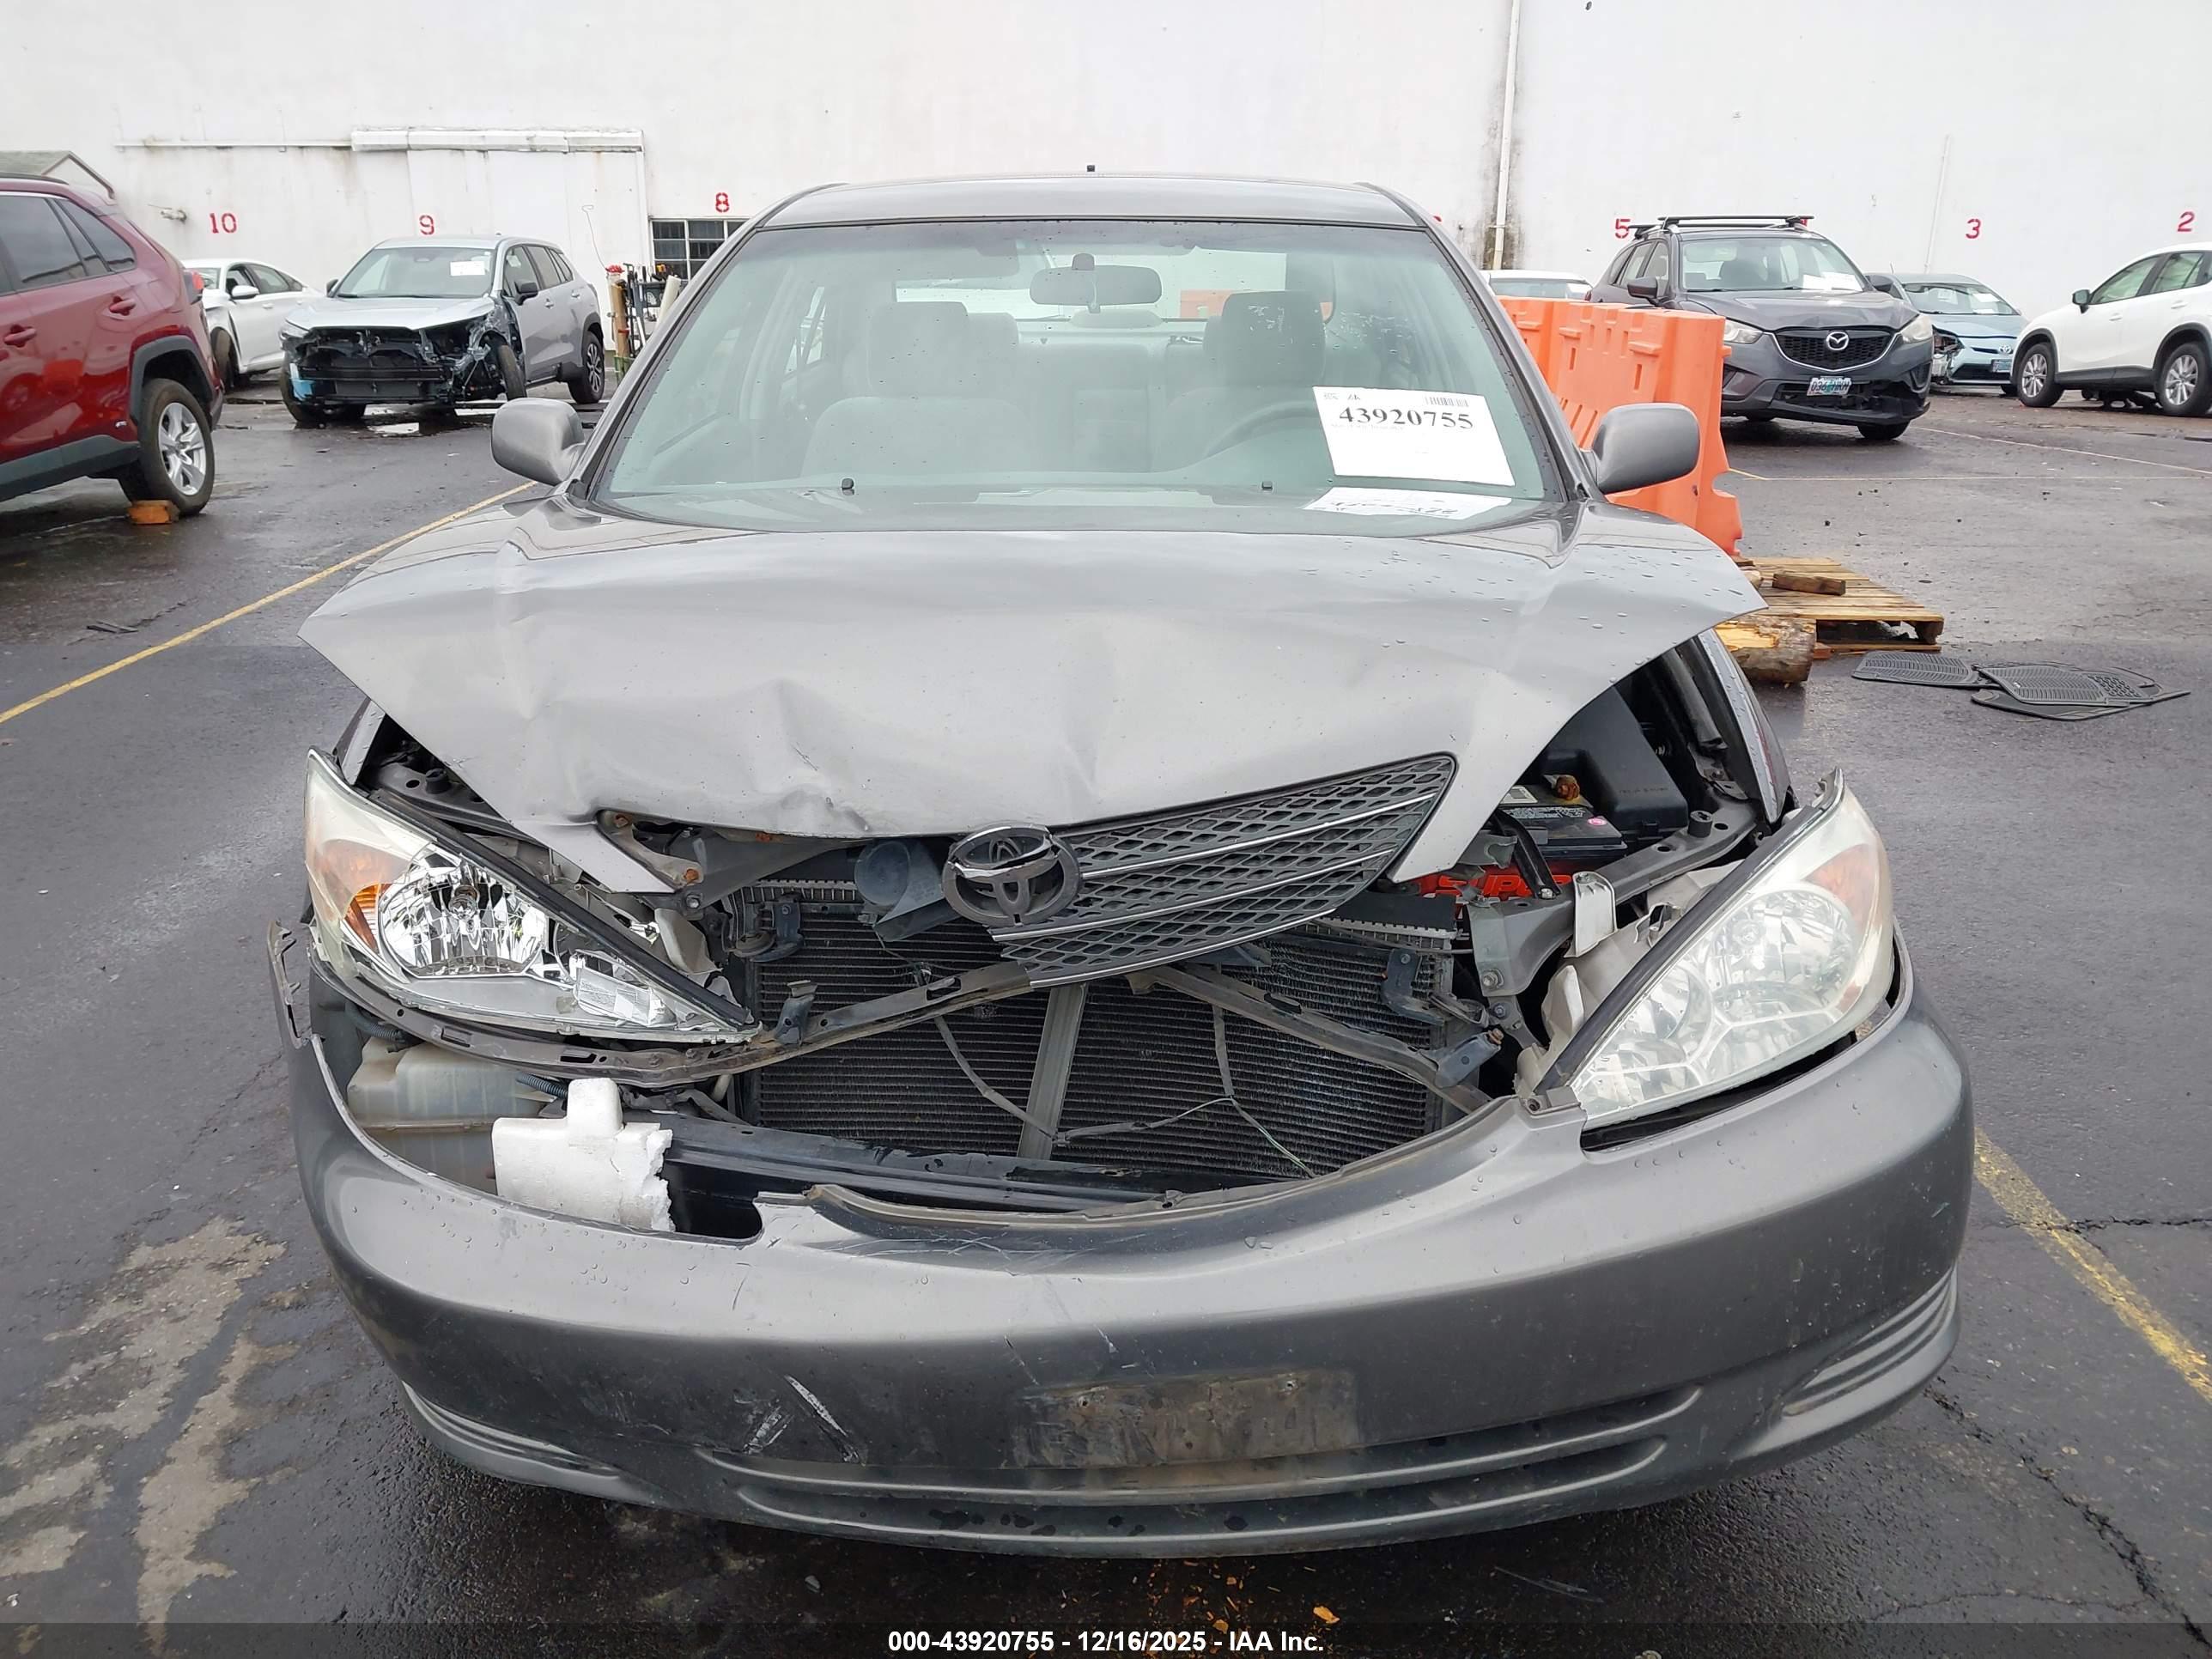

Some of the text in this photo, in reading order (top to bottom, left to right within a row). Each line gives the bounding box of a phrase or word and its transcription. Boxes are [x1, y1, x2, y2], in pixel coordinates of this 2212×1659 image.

[714, 191, 730, 213] 8
[209, 212, 237, 234] 10
[418, 215, 434, 235] 9
[1613, 217, 1632, 240] 5
[1965, 217, 1982, 240] 3
[2177, 211, 2196, 233] 2
[1338, 406, 1474, 429] 43920755
